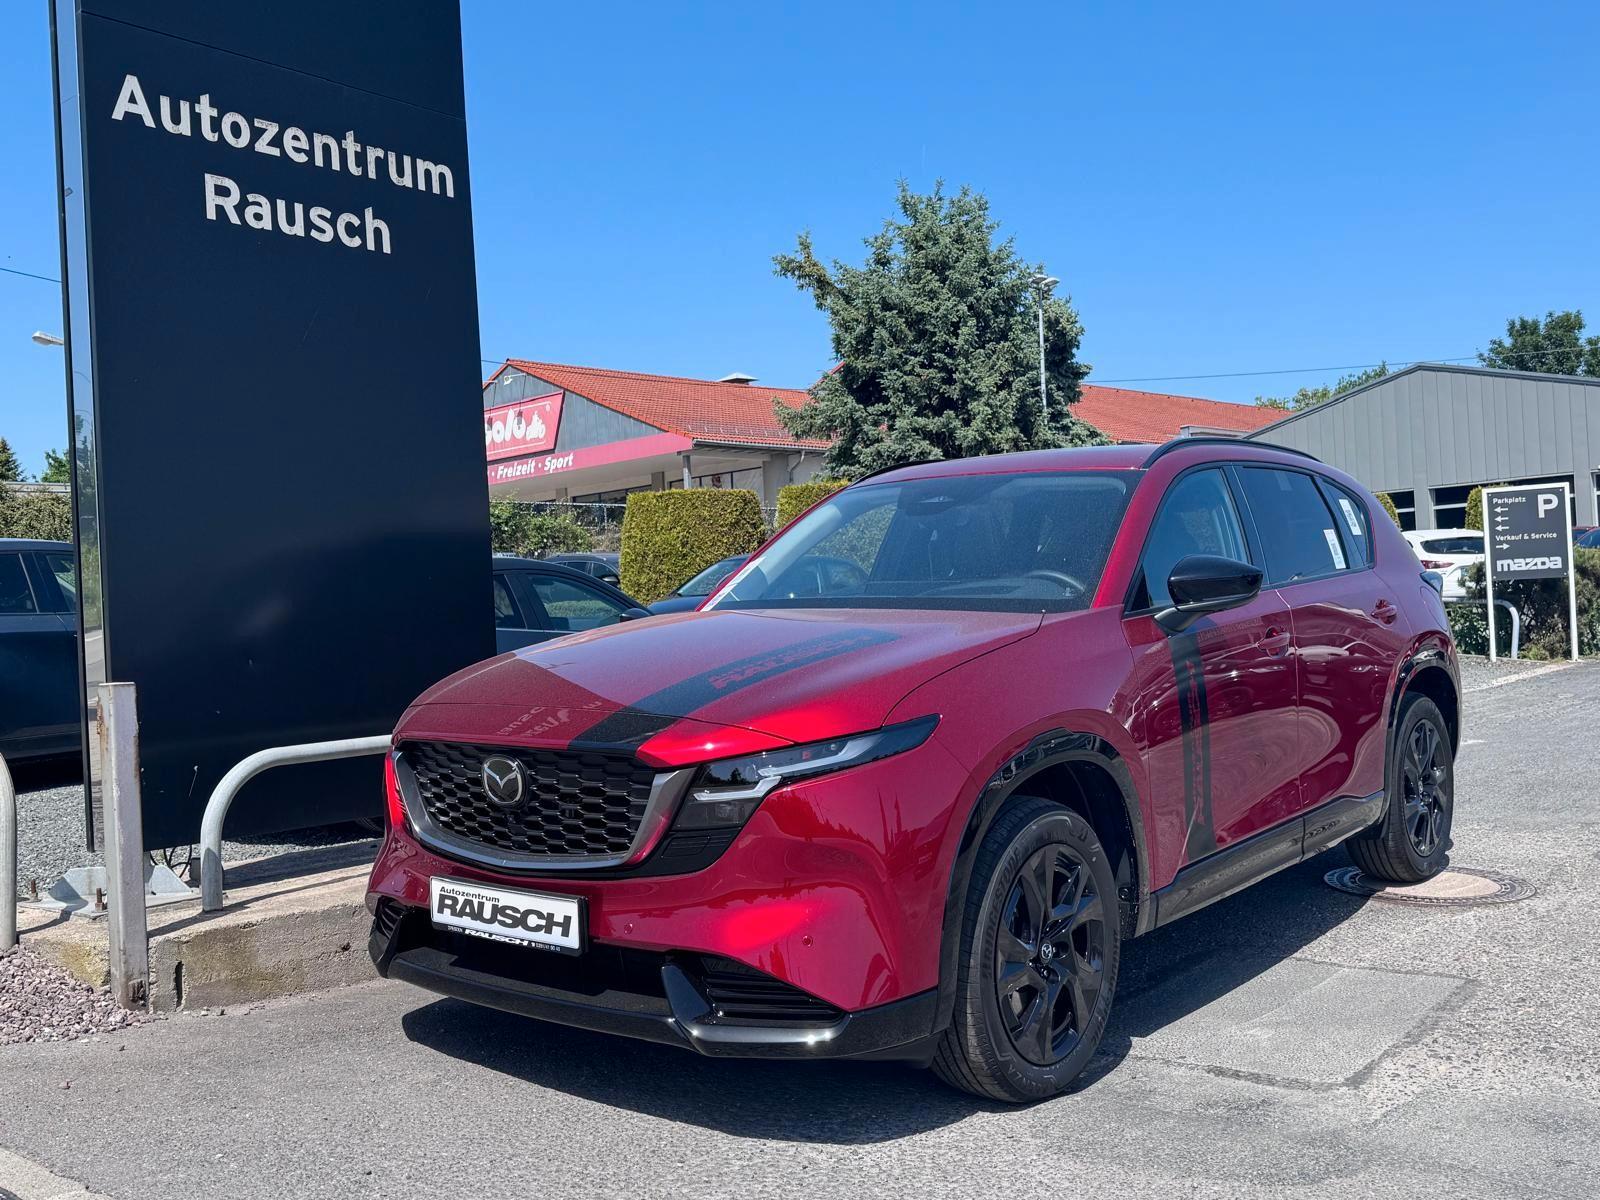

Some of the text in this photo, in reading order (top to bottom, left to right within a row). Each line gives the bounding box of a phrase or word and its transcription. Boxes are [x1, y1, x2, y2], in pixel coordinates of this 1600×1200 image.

[111, 73, 454, 198] Autozentrum
[203, 173, 392, 255] Rausch
[485, 408, 526, 446] olo
[496, 452, 574, 480] Freizeit Sport
[1492, 496, 1527, 505] Parkplatz
[1537, 493, 1559, 518] P
[1495, 533, 1522, 541] Verkauf
[1531, 531, 1558, 540] Service
[439, 885, 500, 904] Autozentrum
[437, 893, 572, 938] RAUSCH
[464, 928, 529, 946] RAUSCH
